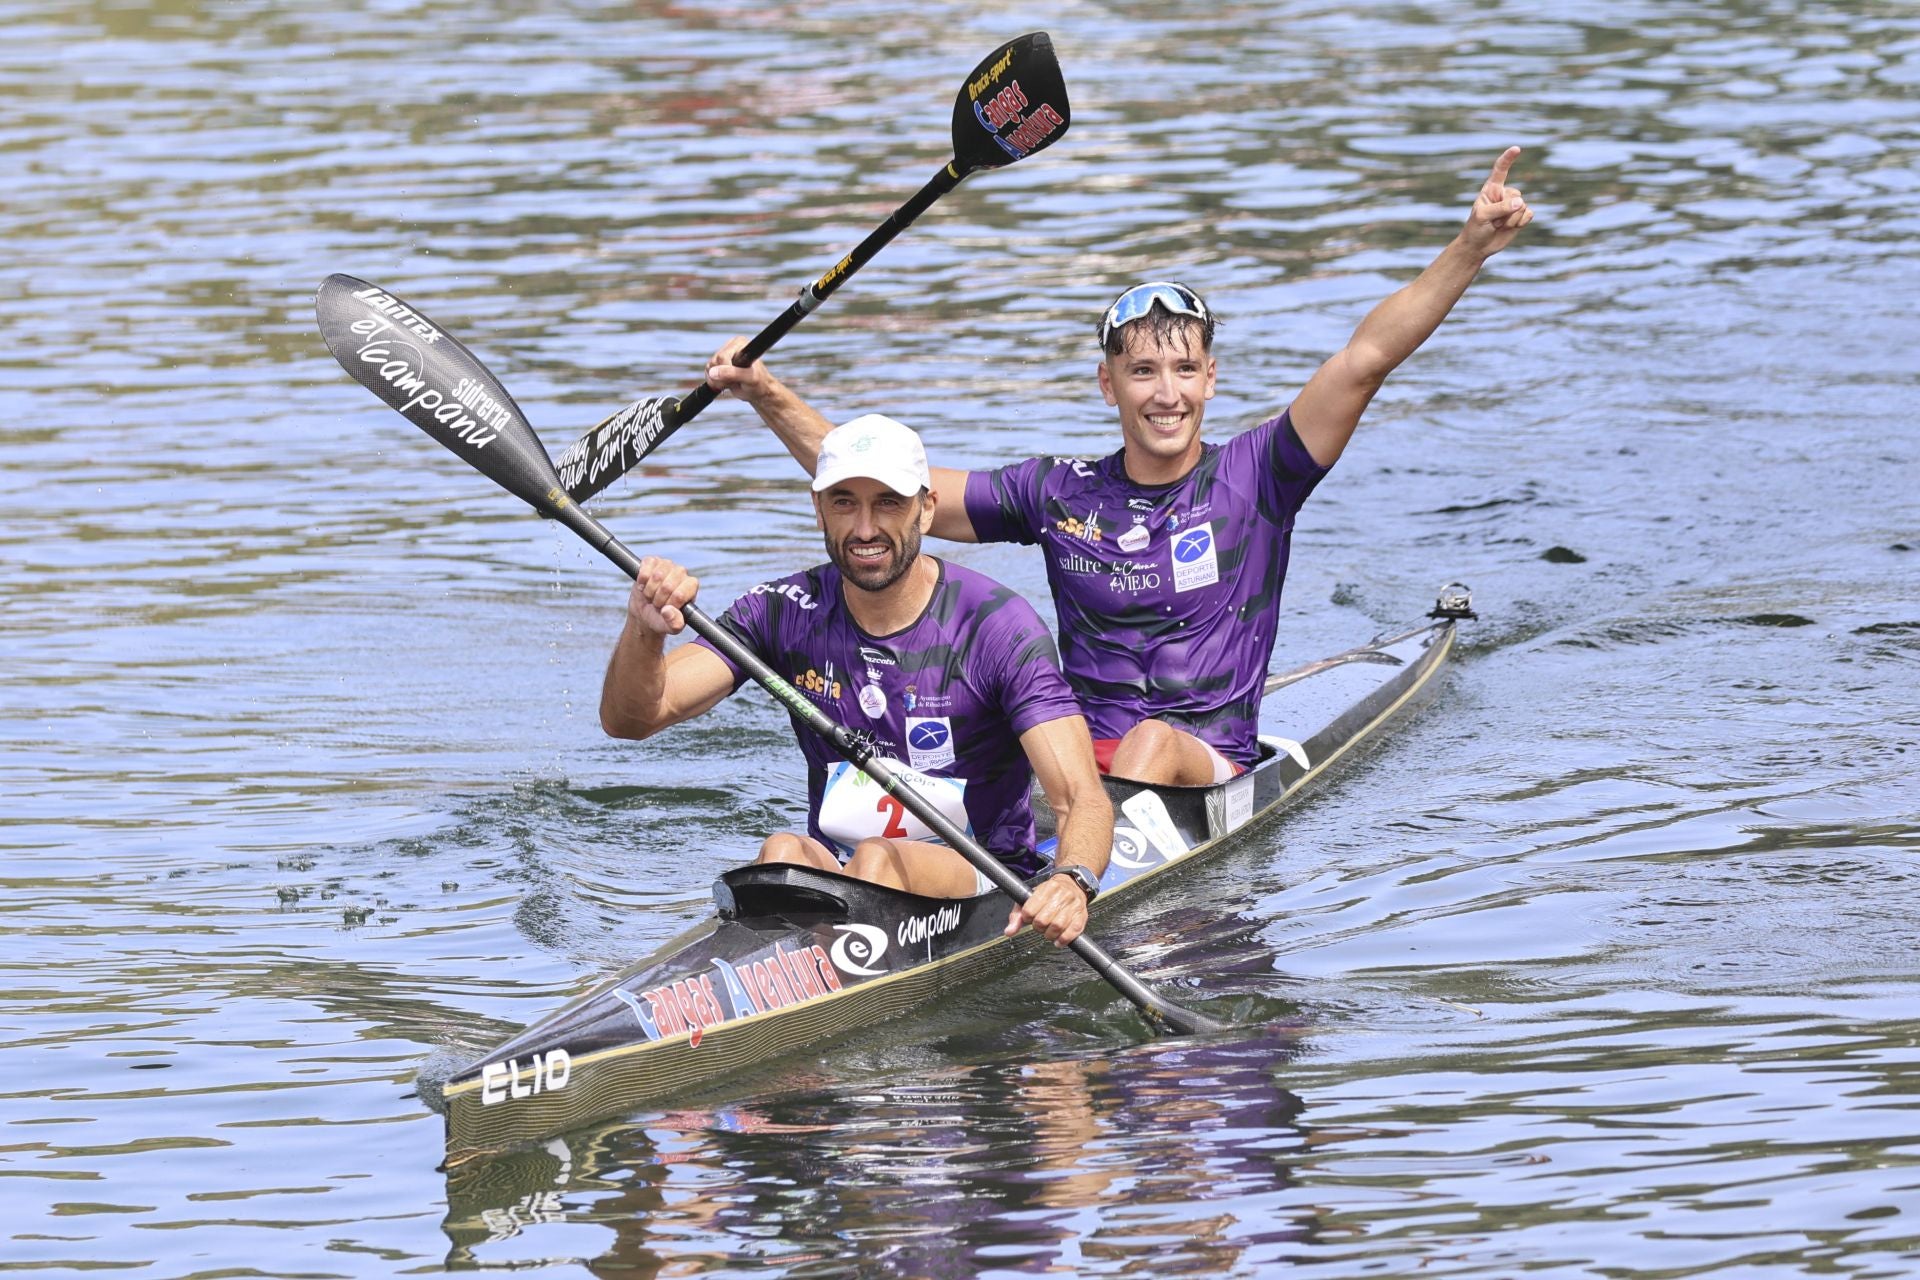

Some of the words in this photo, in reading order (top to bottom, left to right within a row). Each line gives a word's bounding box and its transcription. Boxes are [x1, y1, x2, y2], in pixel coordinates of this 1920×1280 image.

[974, 80, 1028, 133] Cangas
[993, 103, 1064, 160] Aventura
[1059, 553, 1102, 574] salitre
[1119, 573, 1160, 591] VIEJO
[1176, 561, 1215, 577] DEPORTE
[1178, 571, 1216, 586] ASTURIANO
[876, 794, 908, 839] 2
[711, 941, 842, 1020] Aventura
[612, 971, 724, 1048] Cangas
[482, 1048, 571, 1105] ELIO
